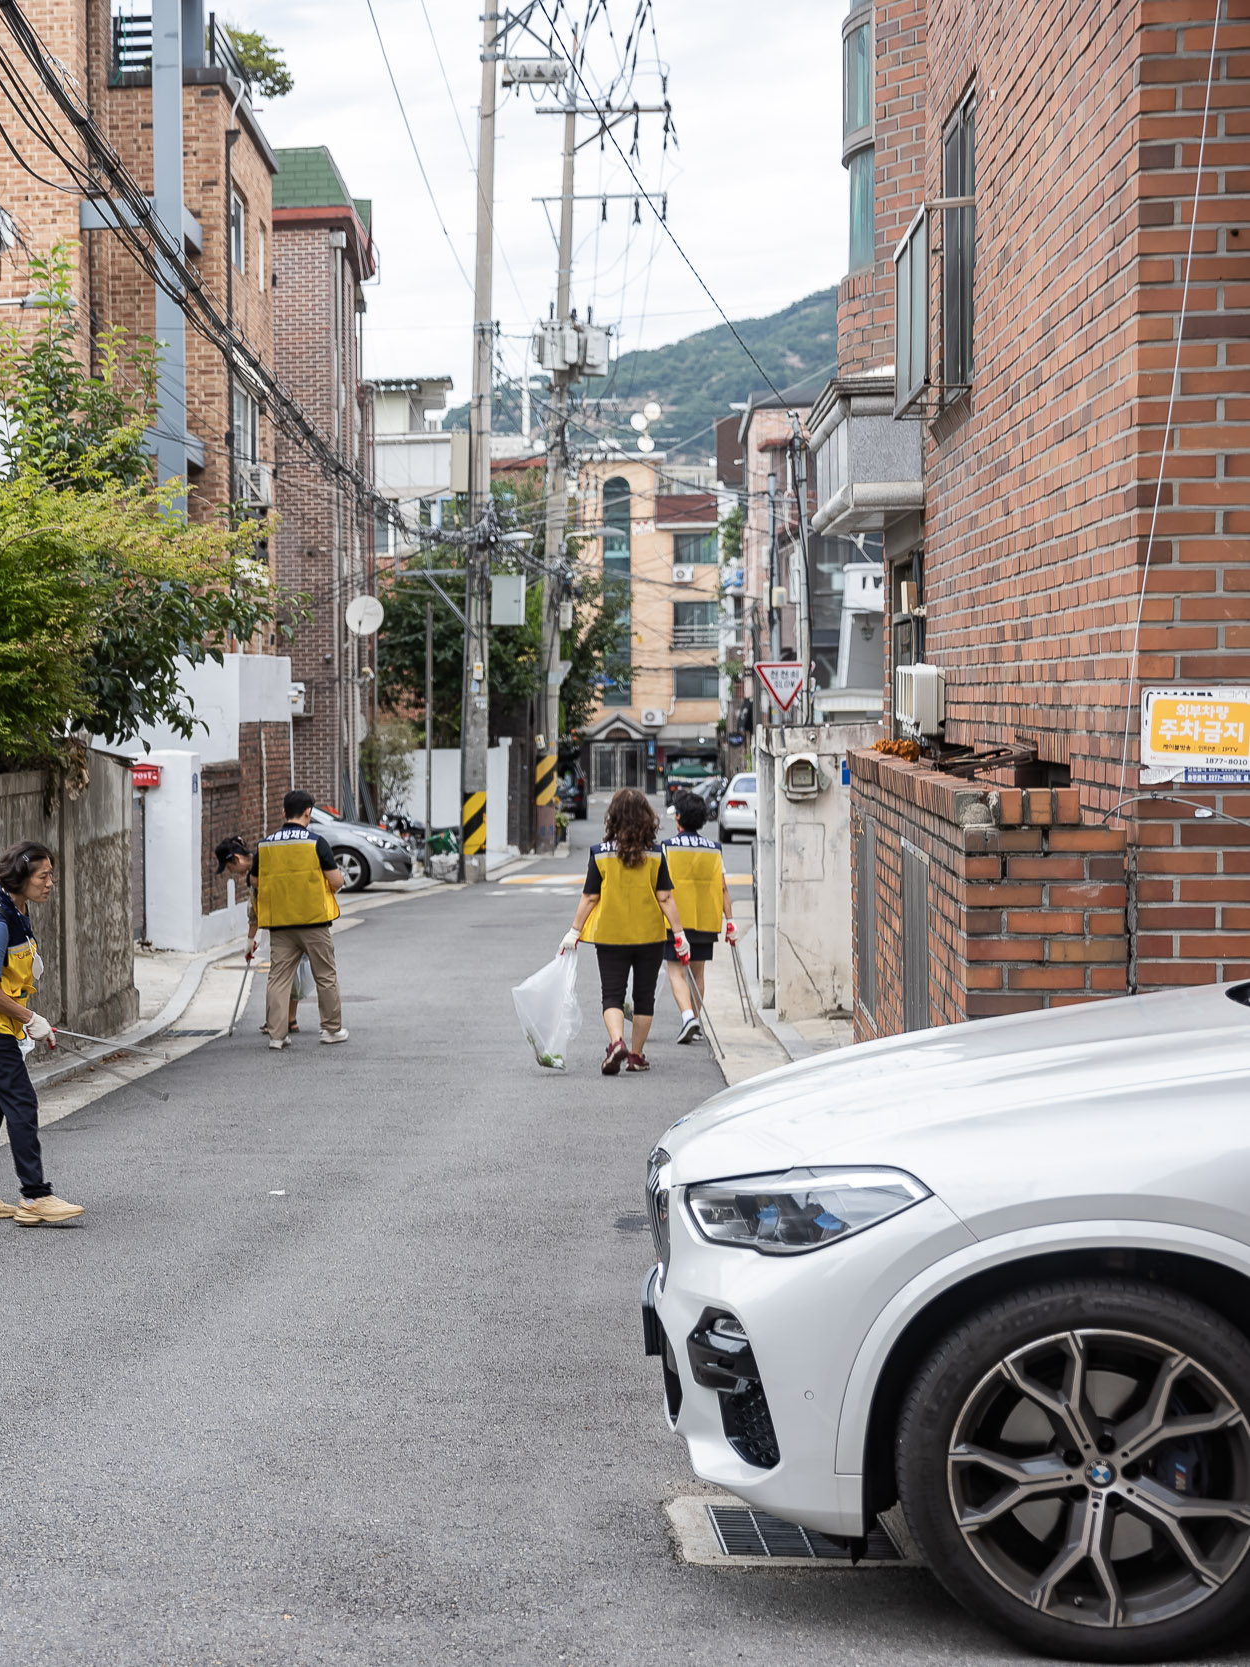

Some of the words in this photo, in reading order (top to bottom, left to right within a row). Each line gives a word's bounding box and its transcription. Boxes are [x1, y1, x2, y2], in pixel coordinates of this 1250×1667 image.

[771, 670, 799, 680] 천천히
[774, 680, 795, 688] SLOW
[1176, 703, 1229, 720] 외부차량
[1158, 718, 1244, 743] 주차금지
[1205, 758, 1248, 766] 1877-8010
[133, 771, 152, 780] POST
